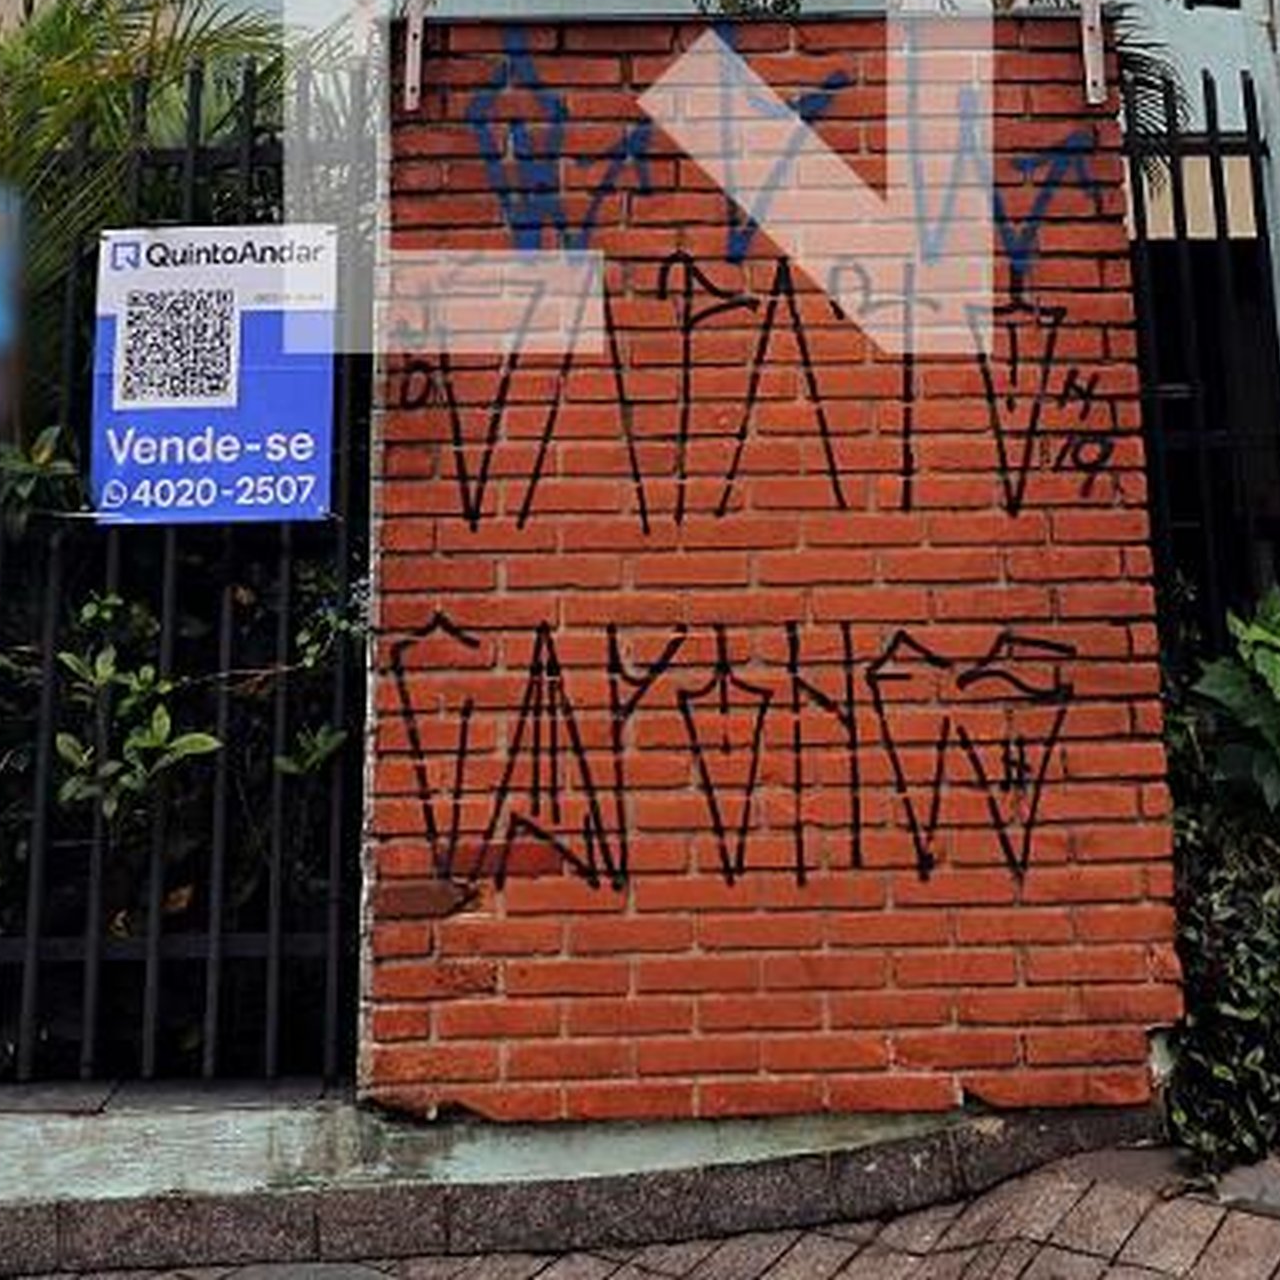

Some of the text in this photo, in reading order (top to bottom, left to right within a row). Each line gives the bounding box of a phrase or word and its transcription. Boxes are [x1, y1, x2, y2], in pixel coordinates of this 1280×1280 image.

[146, 240, 324, 268] QuintoAndar
[106, 426, 315, 466] Vende-se
[131, 475, 317, 507] 4020-2507
